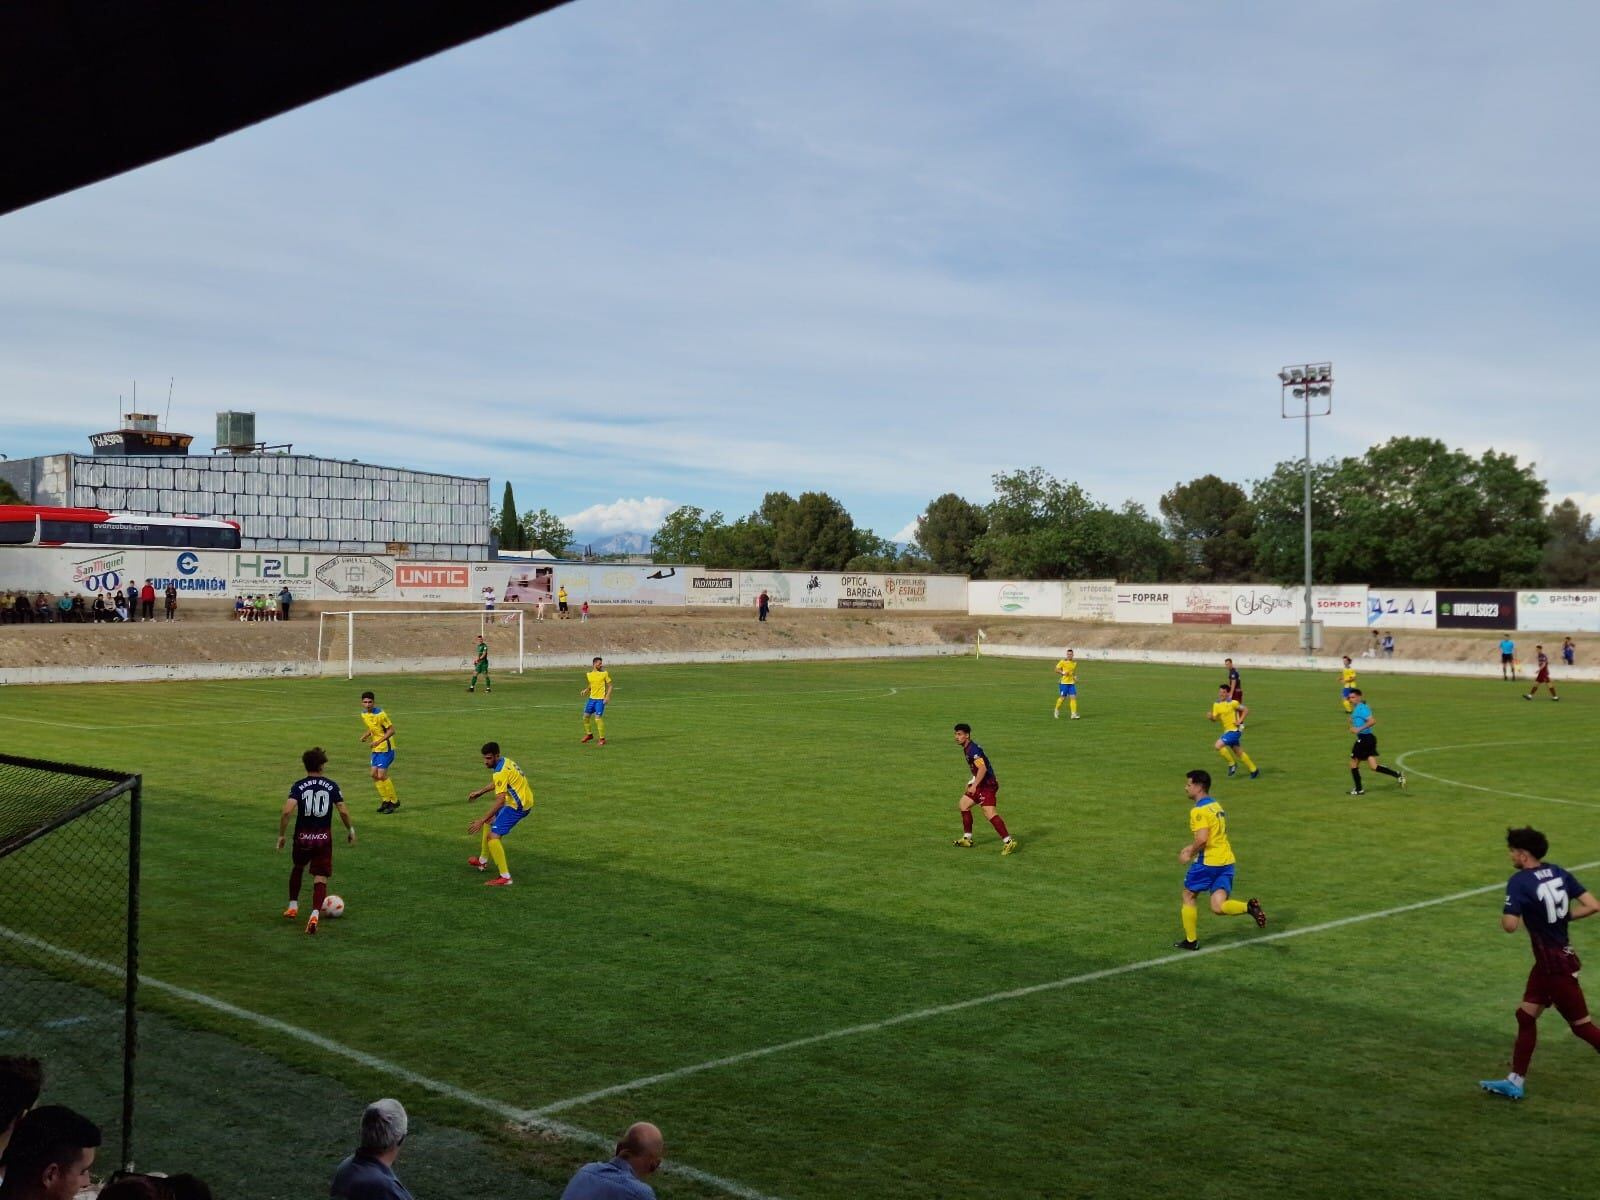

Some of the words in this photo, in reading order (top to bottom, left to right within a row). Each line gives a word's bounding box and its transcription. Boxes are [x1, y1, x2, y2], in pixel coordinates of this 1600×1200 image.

[93, 555, 124, 573] Miguel
[235, 554, 309, 578] H2U
[401, 570, 465, 584] UNITIC
[1132, 593, 1169, 602] FOPRAR
[1317, 601, 1361, 609] SOMPORT
[301, 789, 329, 817] 10
[1537, 877, 1569, 924] 15
